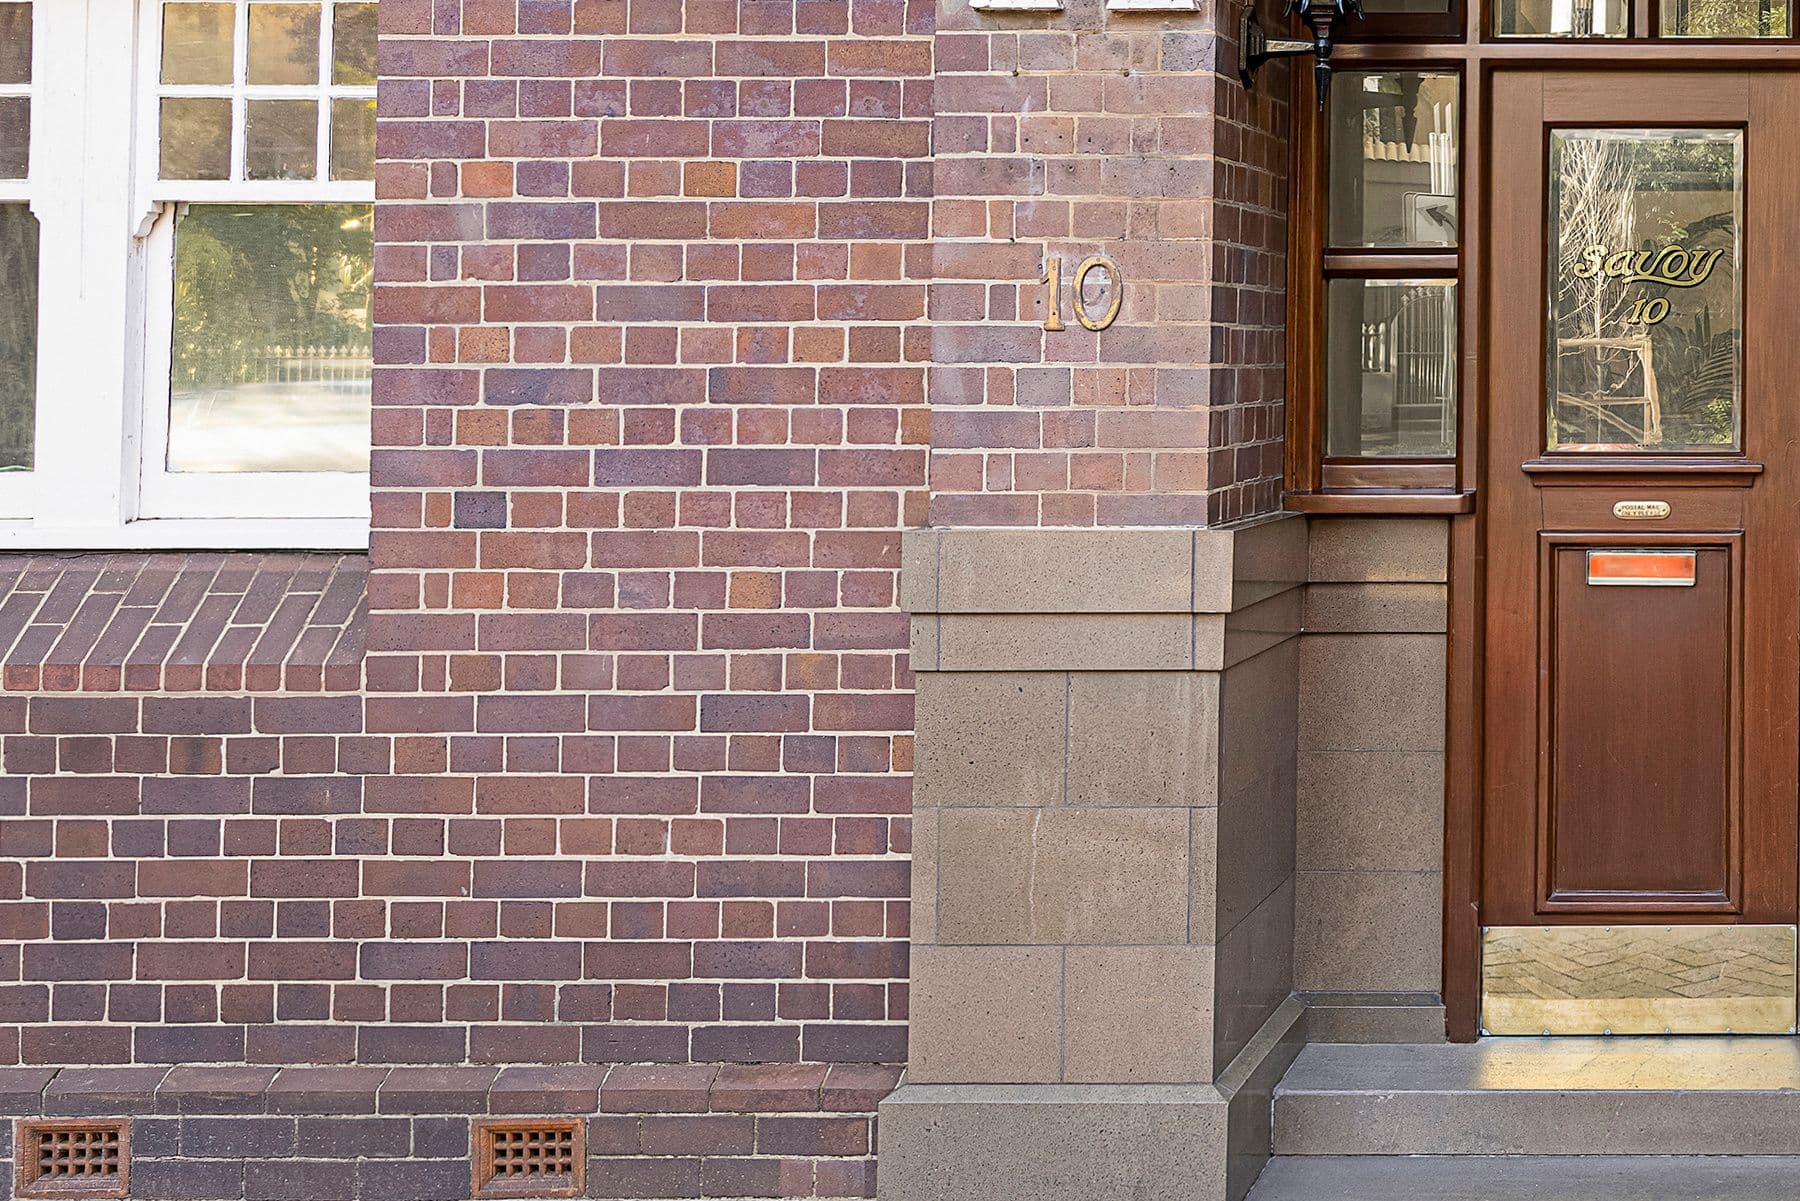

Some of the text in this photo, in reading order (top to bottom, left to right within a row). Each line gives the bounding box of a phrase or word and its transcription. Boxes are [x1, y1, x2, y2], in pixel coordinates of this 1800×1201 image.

[1573, 244, 1724, 288] Savoy
[1040, 256, 1123, 331] 10
[1626, 297, 1671, 326] 10
